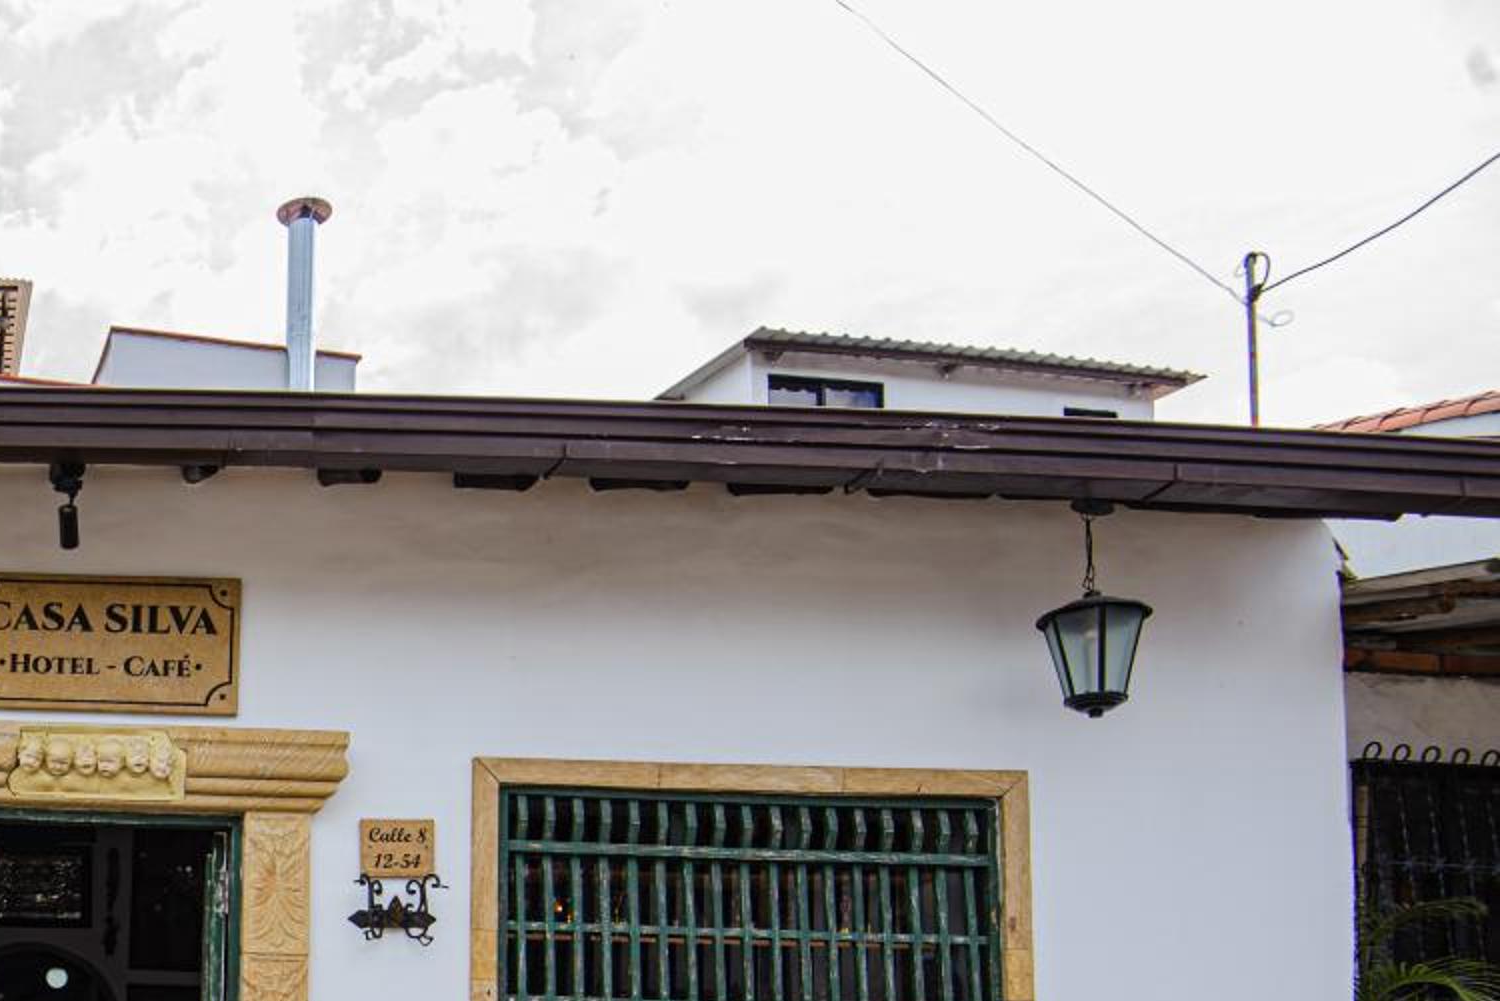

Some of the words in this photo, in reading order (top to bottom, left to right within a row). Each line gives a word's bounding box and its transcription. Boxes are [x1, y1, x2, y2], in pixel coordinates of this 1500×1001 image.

[104, 603, 218, 635] SILVA
[9, 653, 100, 676] HOTEL
[123, 654, 191, 678] CAFÉ
[369, 828, 412, 843] Calle
[418, 828, 427, 843] 8
[374, 853, 421, 868] 12-54
